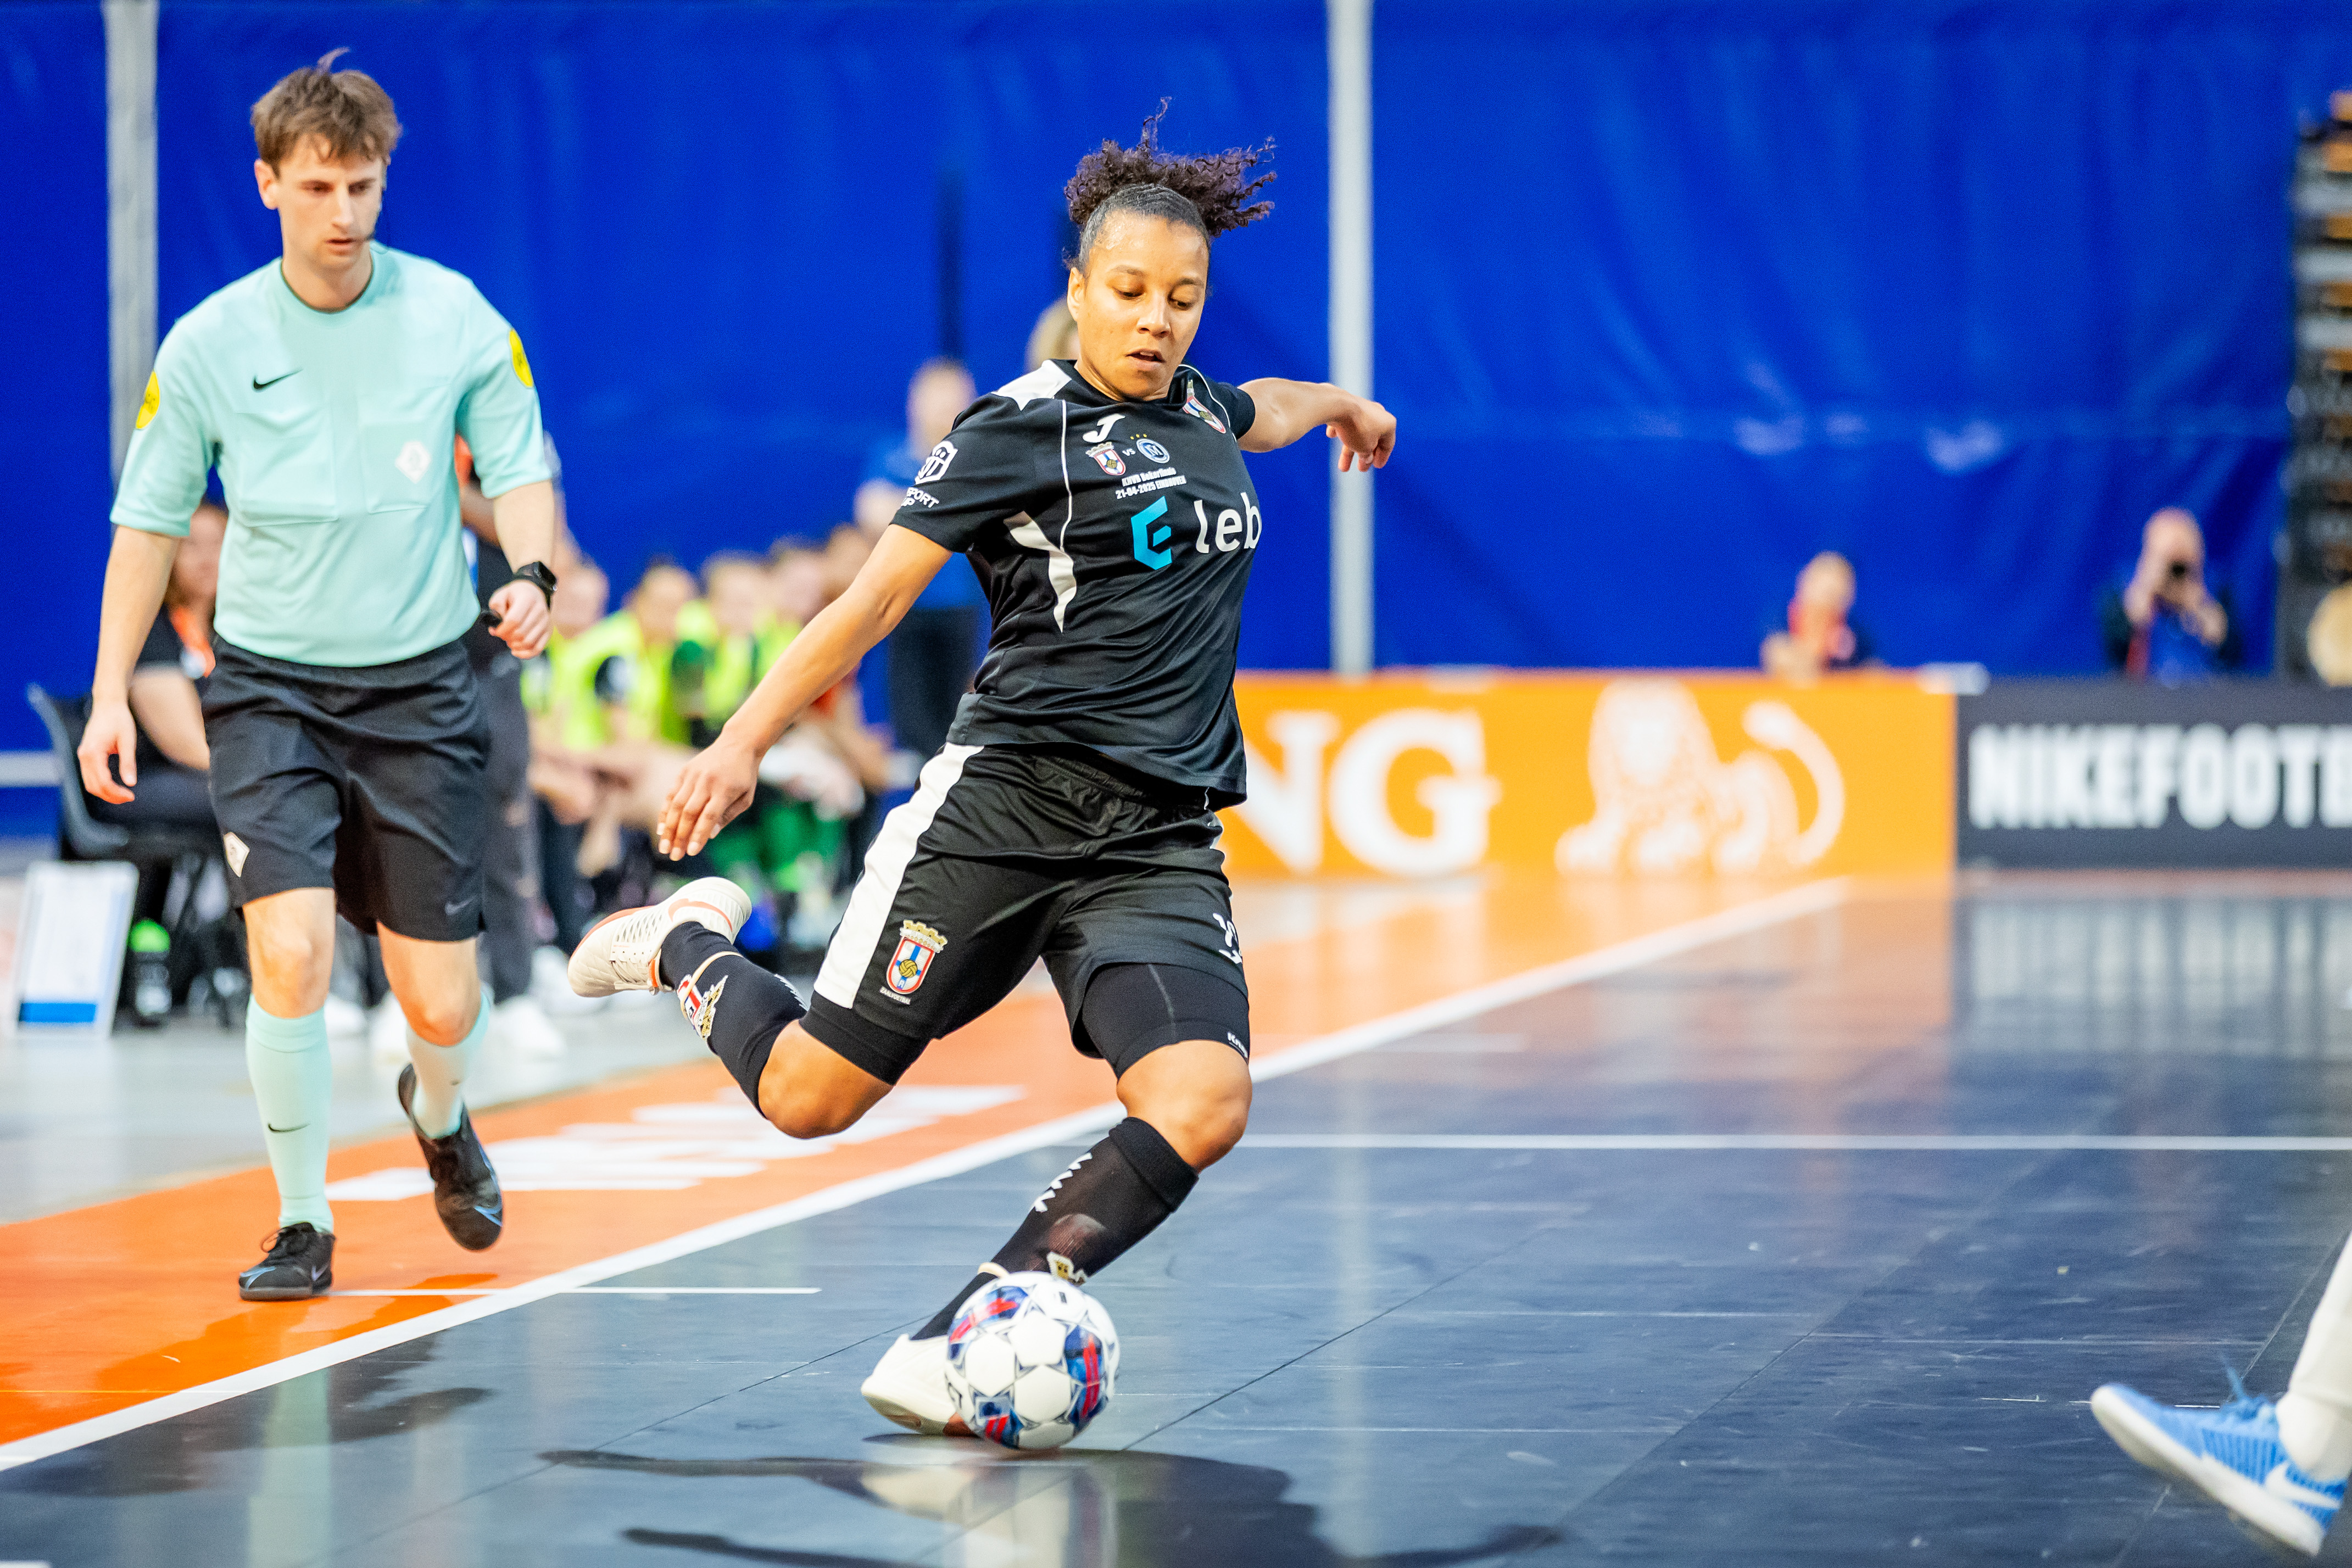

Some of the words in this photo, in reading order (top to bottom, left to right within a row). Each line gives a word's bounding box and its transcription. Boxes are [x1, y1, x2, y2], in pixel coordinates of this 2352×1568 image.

[1116, 481, 1156, 499] 21-04-2025
[1155, 475, 1186, 489] EINDHOVEN
[879, 986, 911, 1005] ZAALVOETBAL
